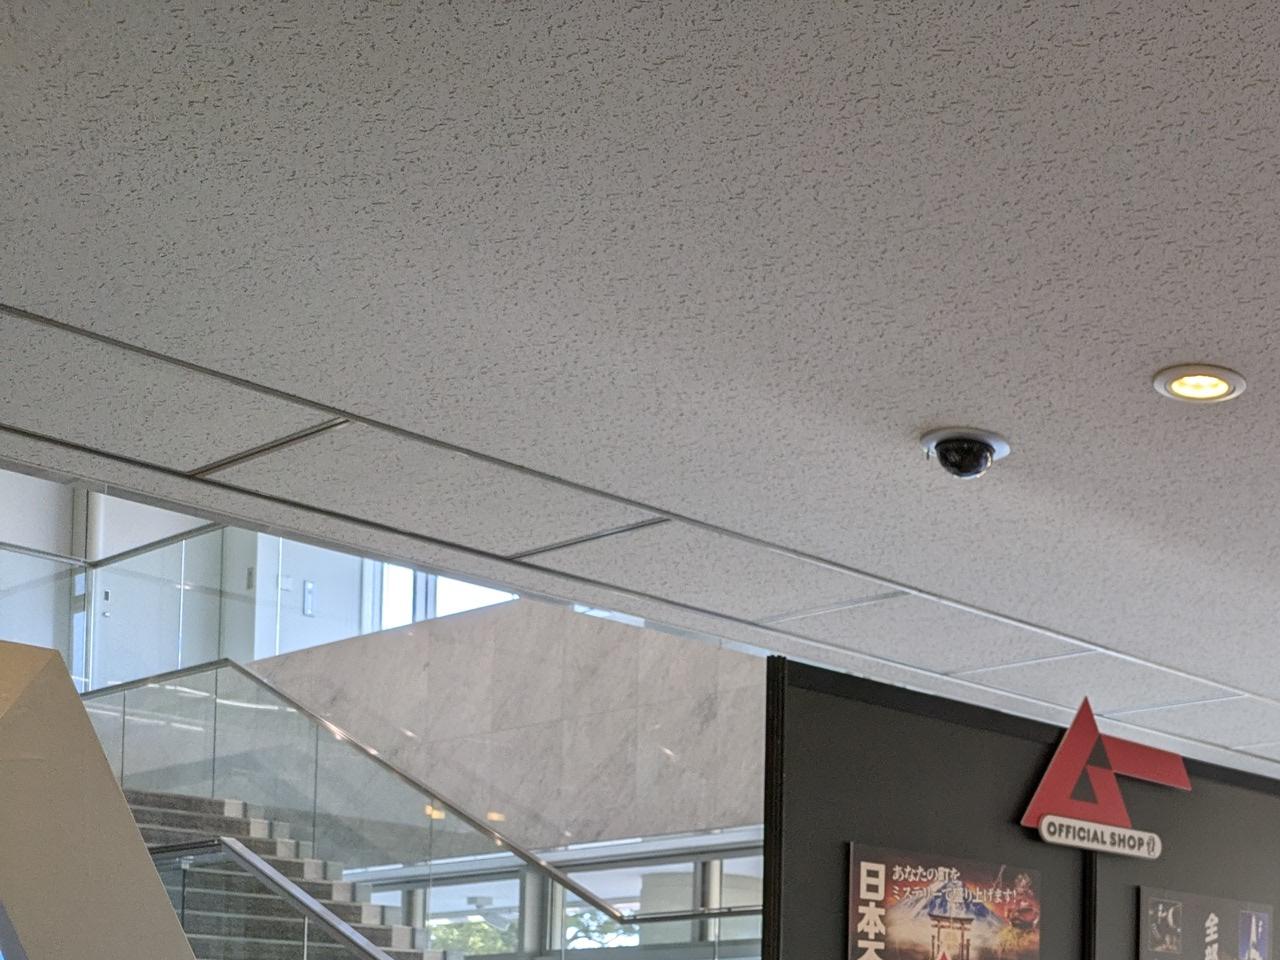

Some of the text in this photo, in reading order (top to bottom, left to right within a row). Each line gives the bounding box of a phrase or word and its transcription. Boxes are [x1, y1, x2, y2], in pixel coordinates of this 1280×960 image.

[1046, 821, 1145, 852] OFFICIAL SHOP
[892, 864, 961, 883] あなたの町を
